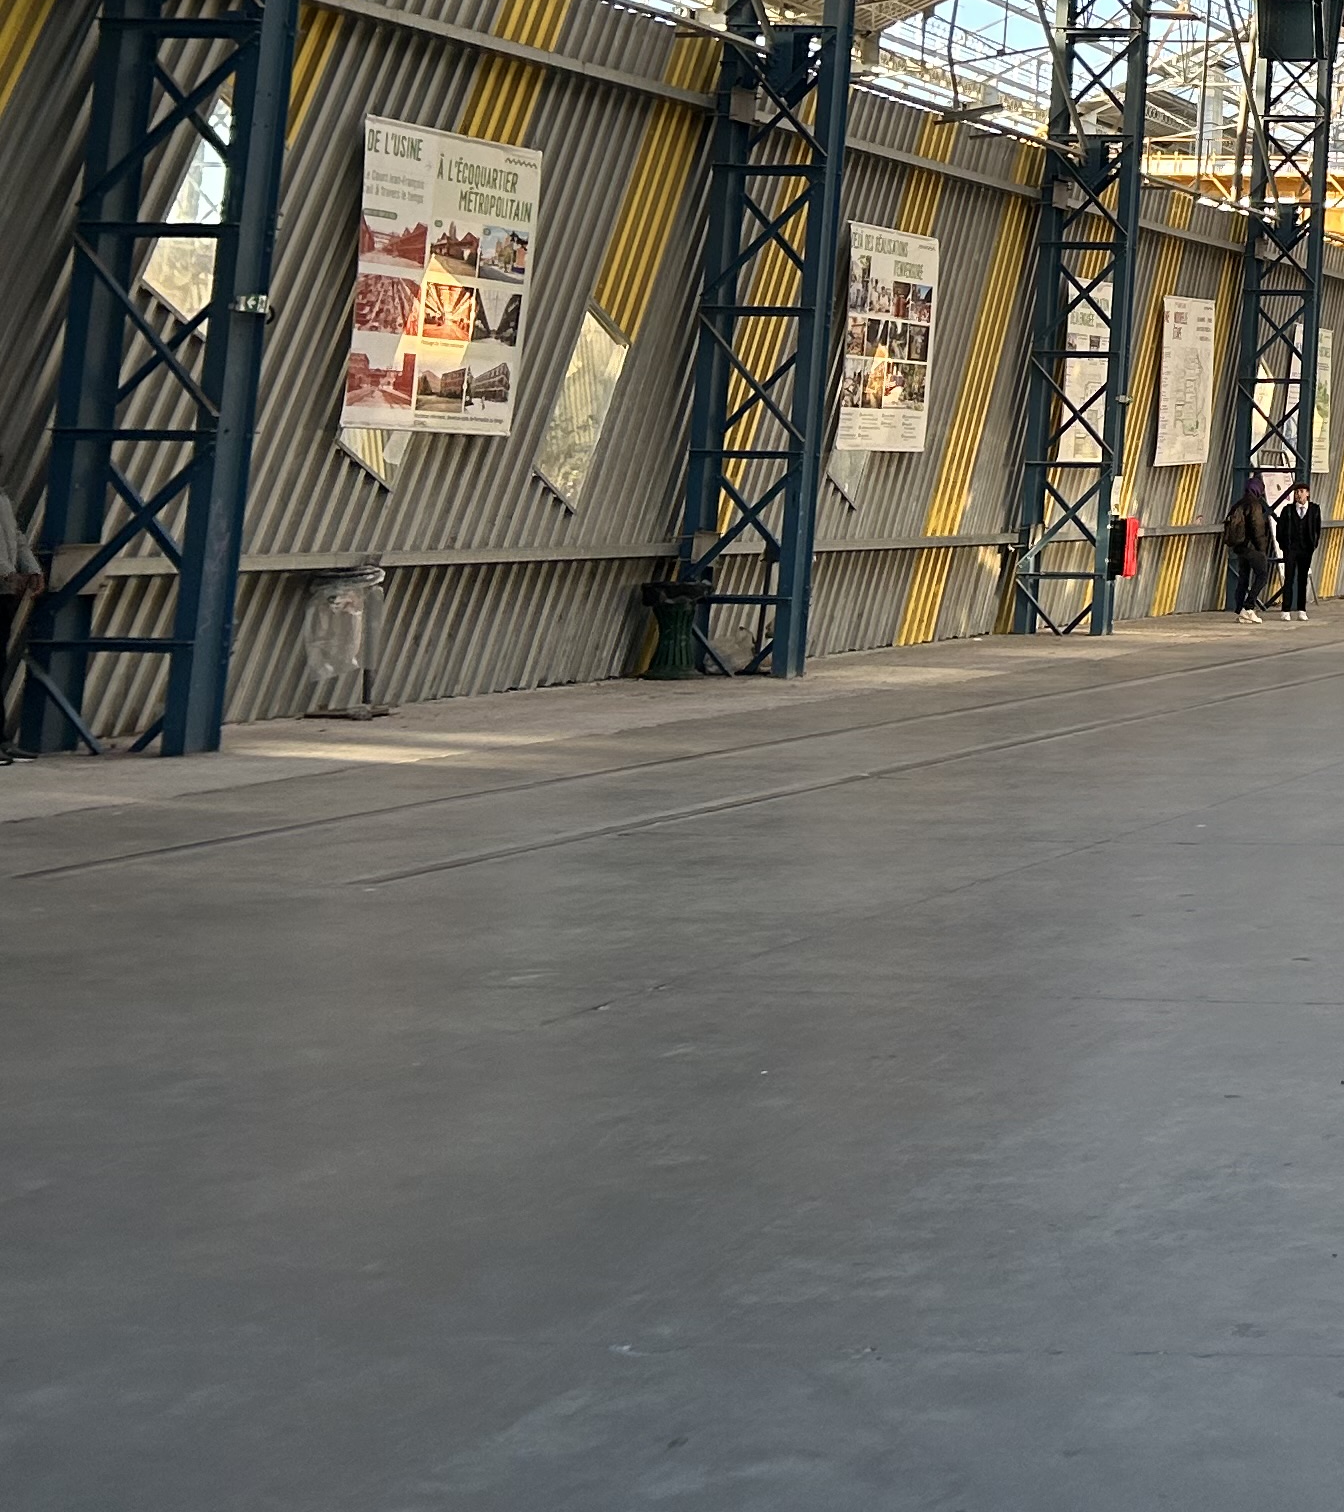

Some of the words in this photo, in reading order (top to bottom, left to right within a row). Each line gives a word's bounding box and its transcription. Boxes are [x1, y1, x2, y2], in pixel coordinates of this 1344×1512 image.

[367, 129, 381, 152] DE
[385, 133, 423, 161] L'USINE
[437, 153, 445, 180] À
[448, 157, 519, 194] L'ÉCOQUARTIER
[458, 188, 534, 223] MÉTROPOLITAIN
